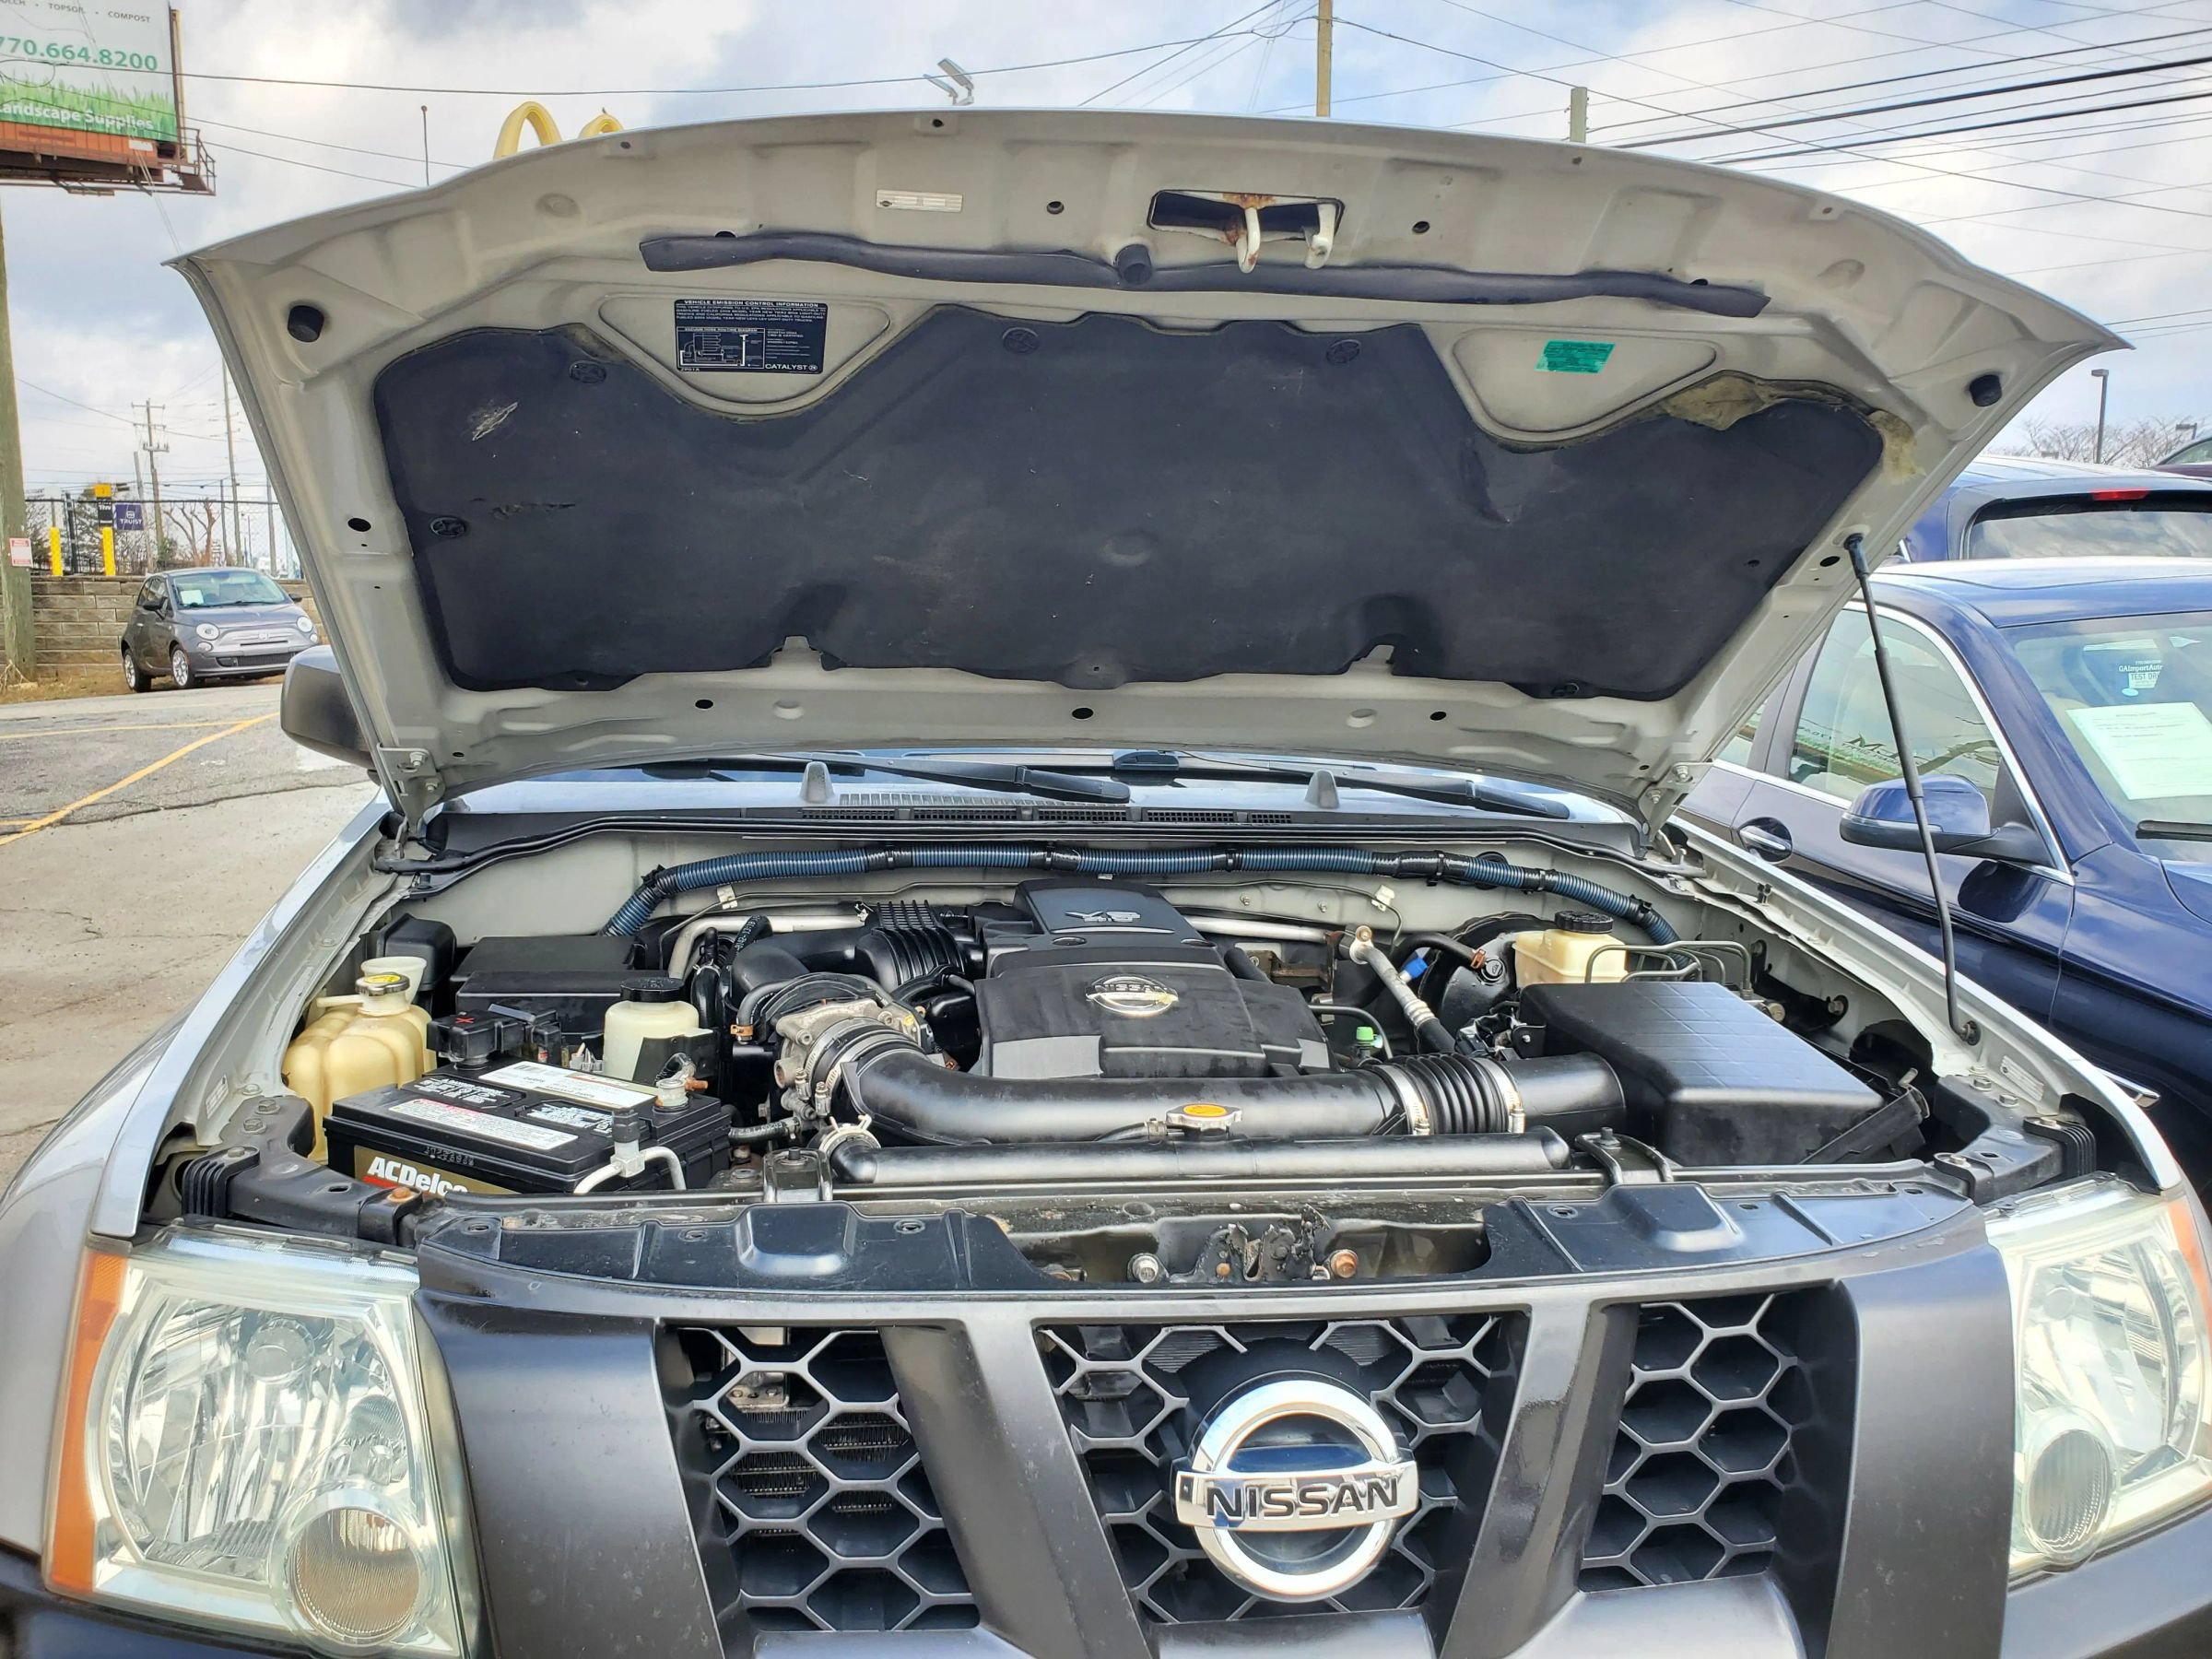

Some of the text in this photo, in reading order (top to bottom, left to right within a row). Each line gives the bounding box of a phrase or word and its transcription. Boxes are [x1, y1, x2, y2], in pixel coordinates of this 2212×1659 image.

[108, 10, 151, 23] COMPOST
[85, 110, 155, 131] Supplies
[1206, 1477, 1399, 1519] NISSAN
